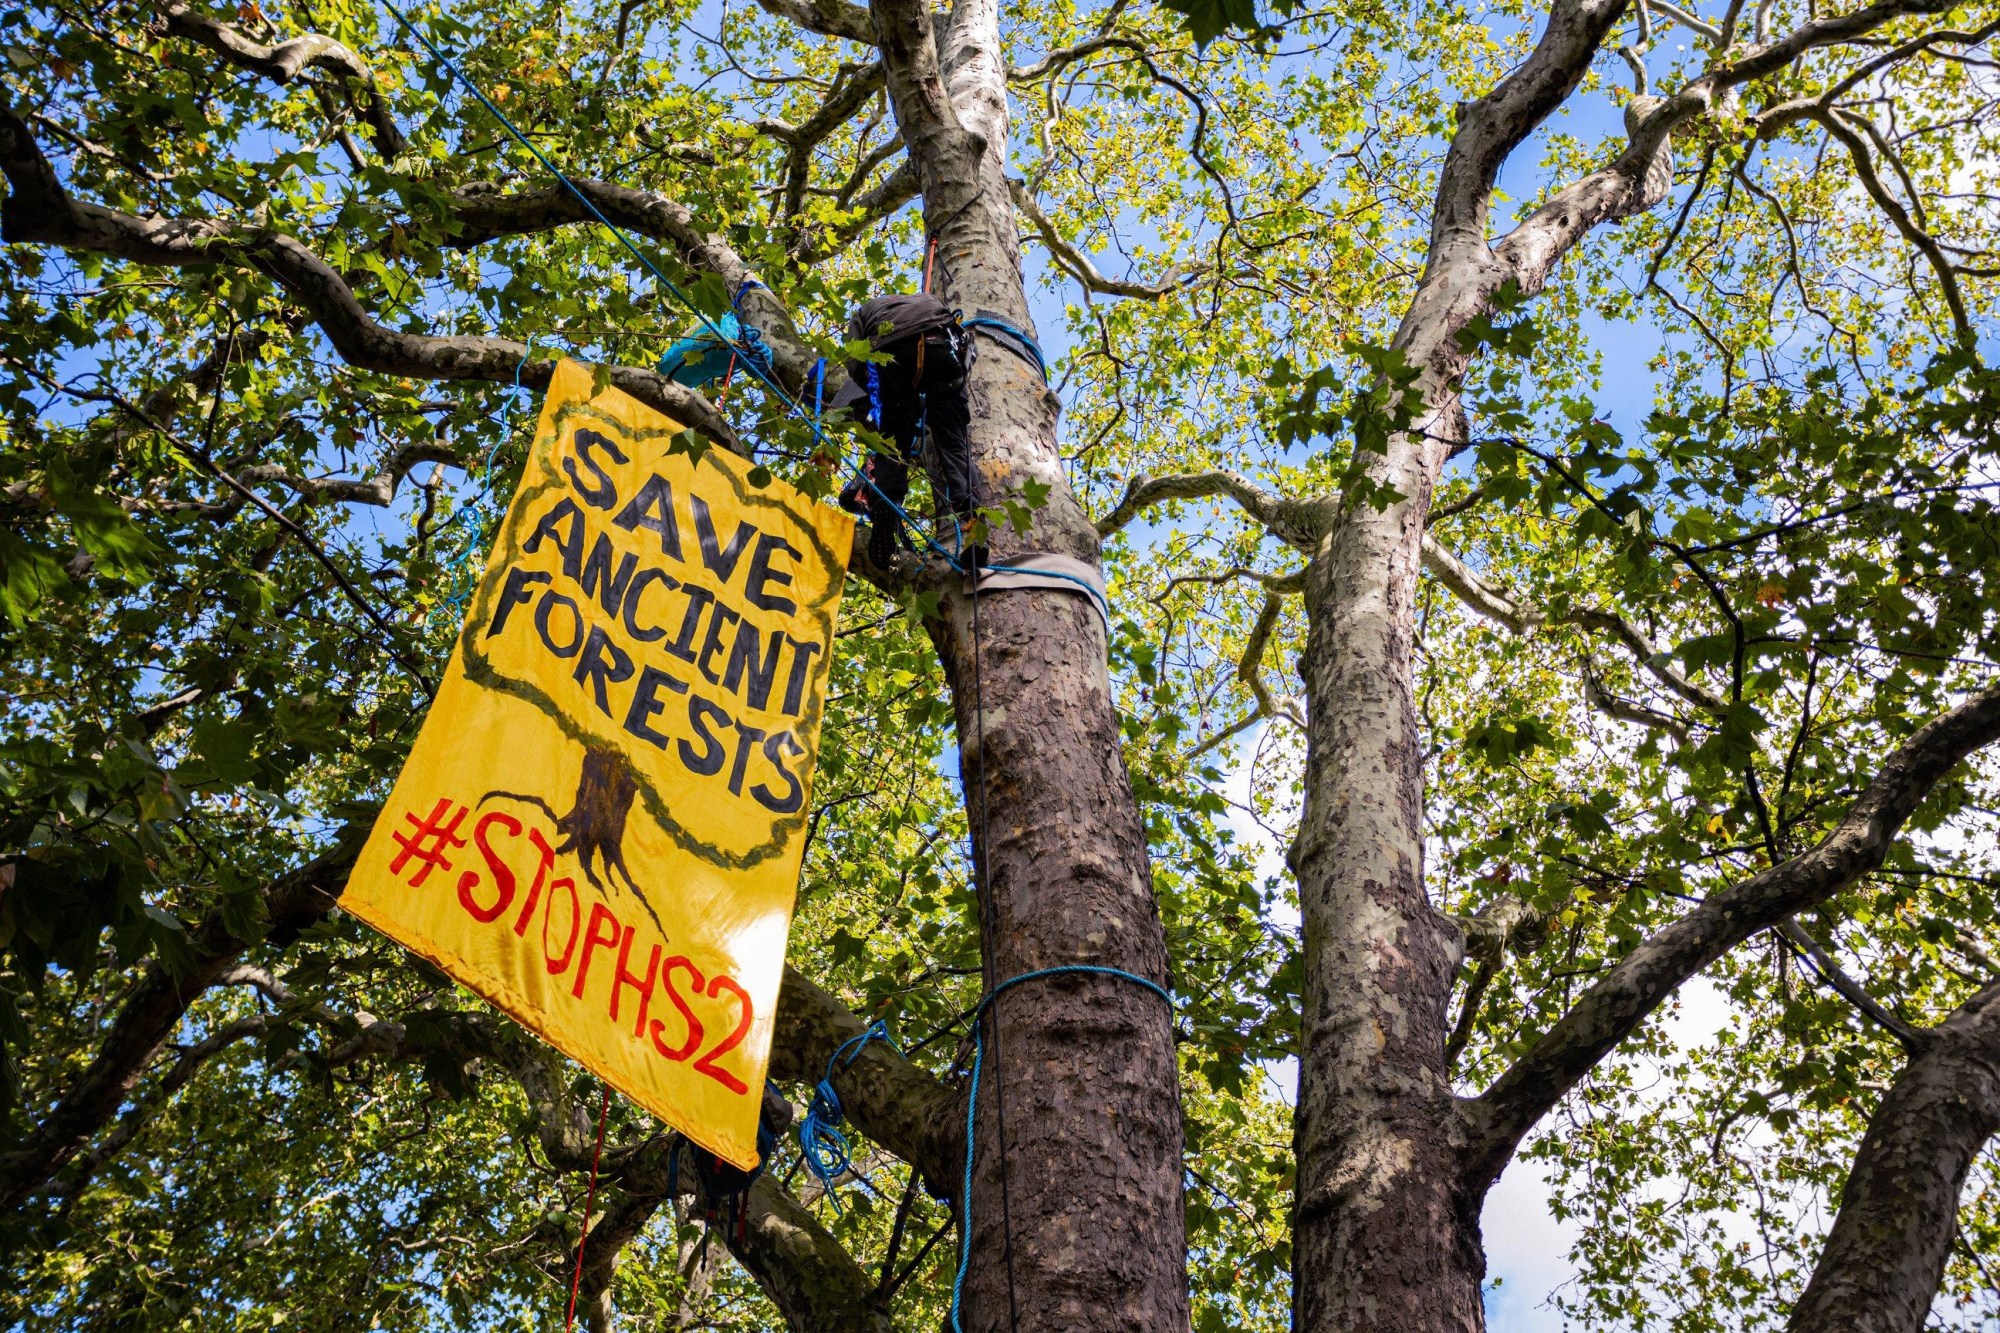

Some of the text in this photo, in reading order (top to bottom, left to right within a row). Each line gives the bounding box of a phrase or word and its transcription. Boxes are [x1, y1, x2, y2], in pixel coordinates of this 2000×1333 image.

[523, 497, 820, 717] ANCIENT
[563, 428, 802, 617] SAVE
[487, 567, 805, 813] FORESTS
[389, 798, 754, 1095] #STOPHS2
